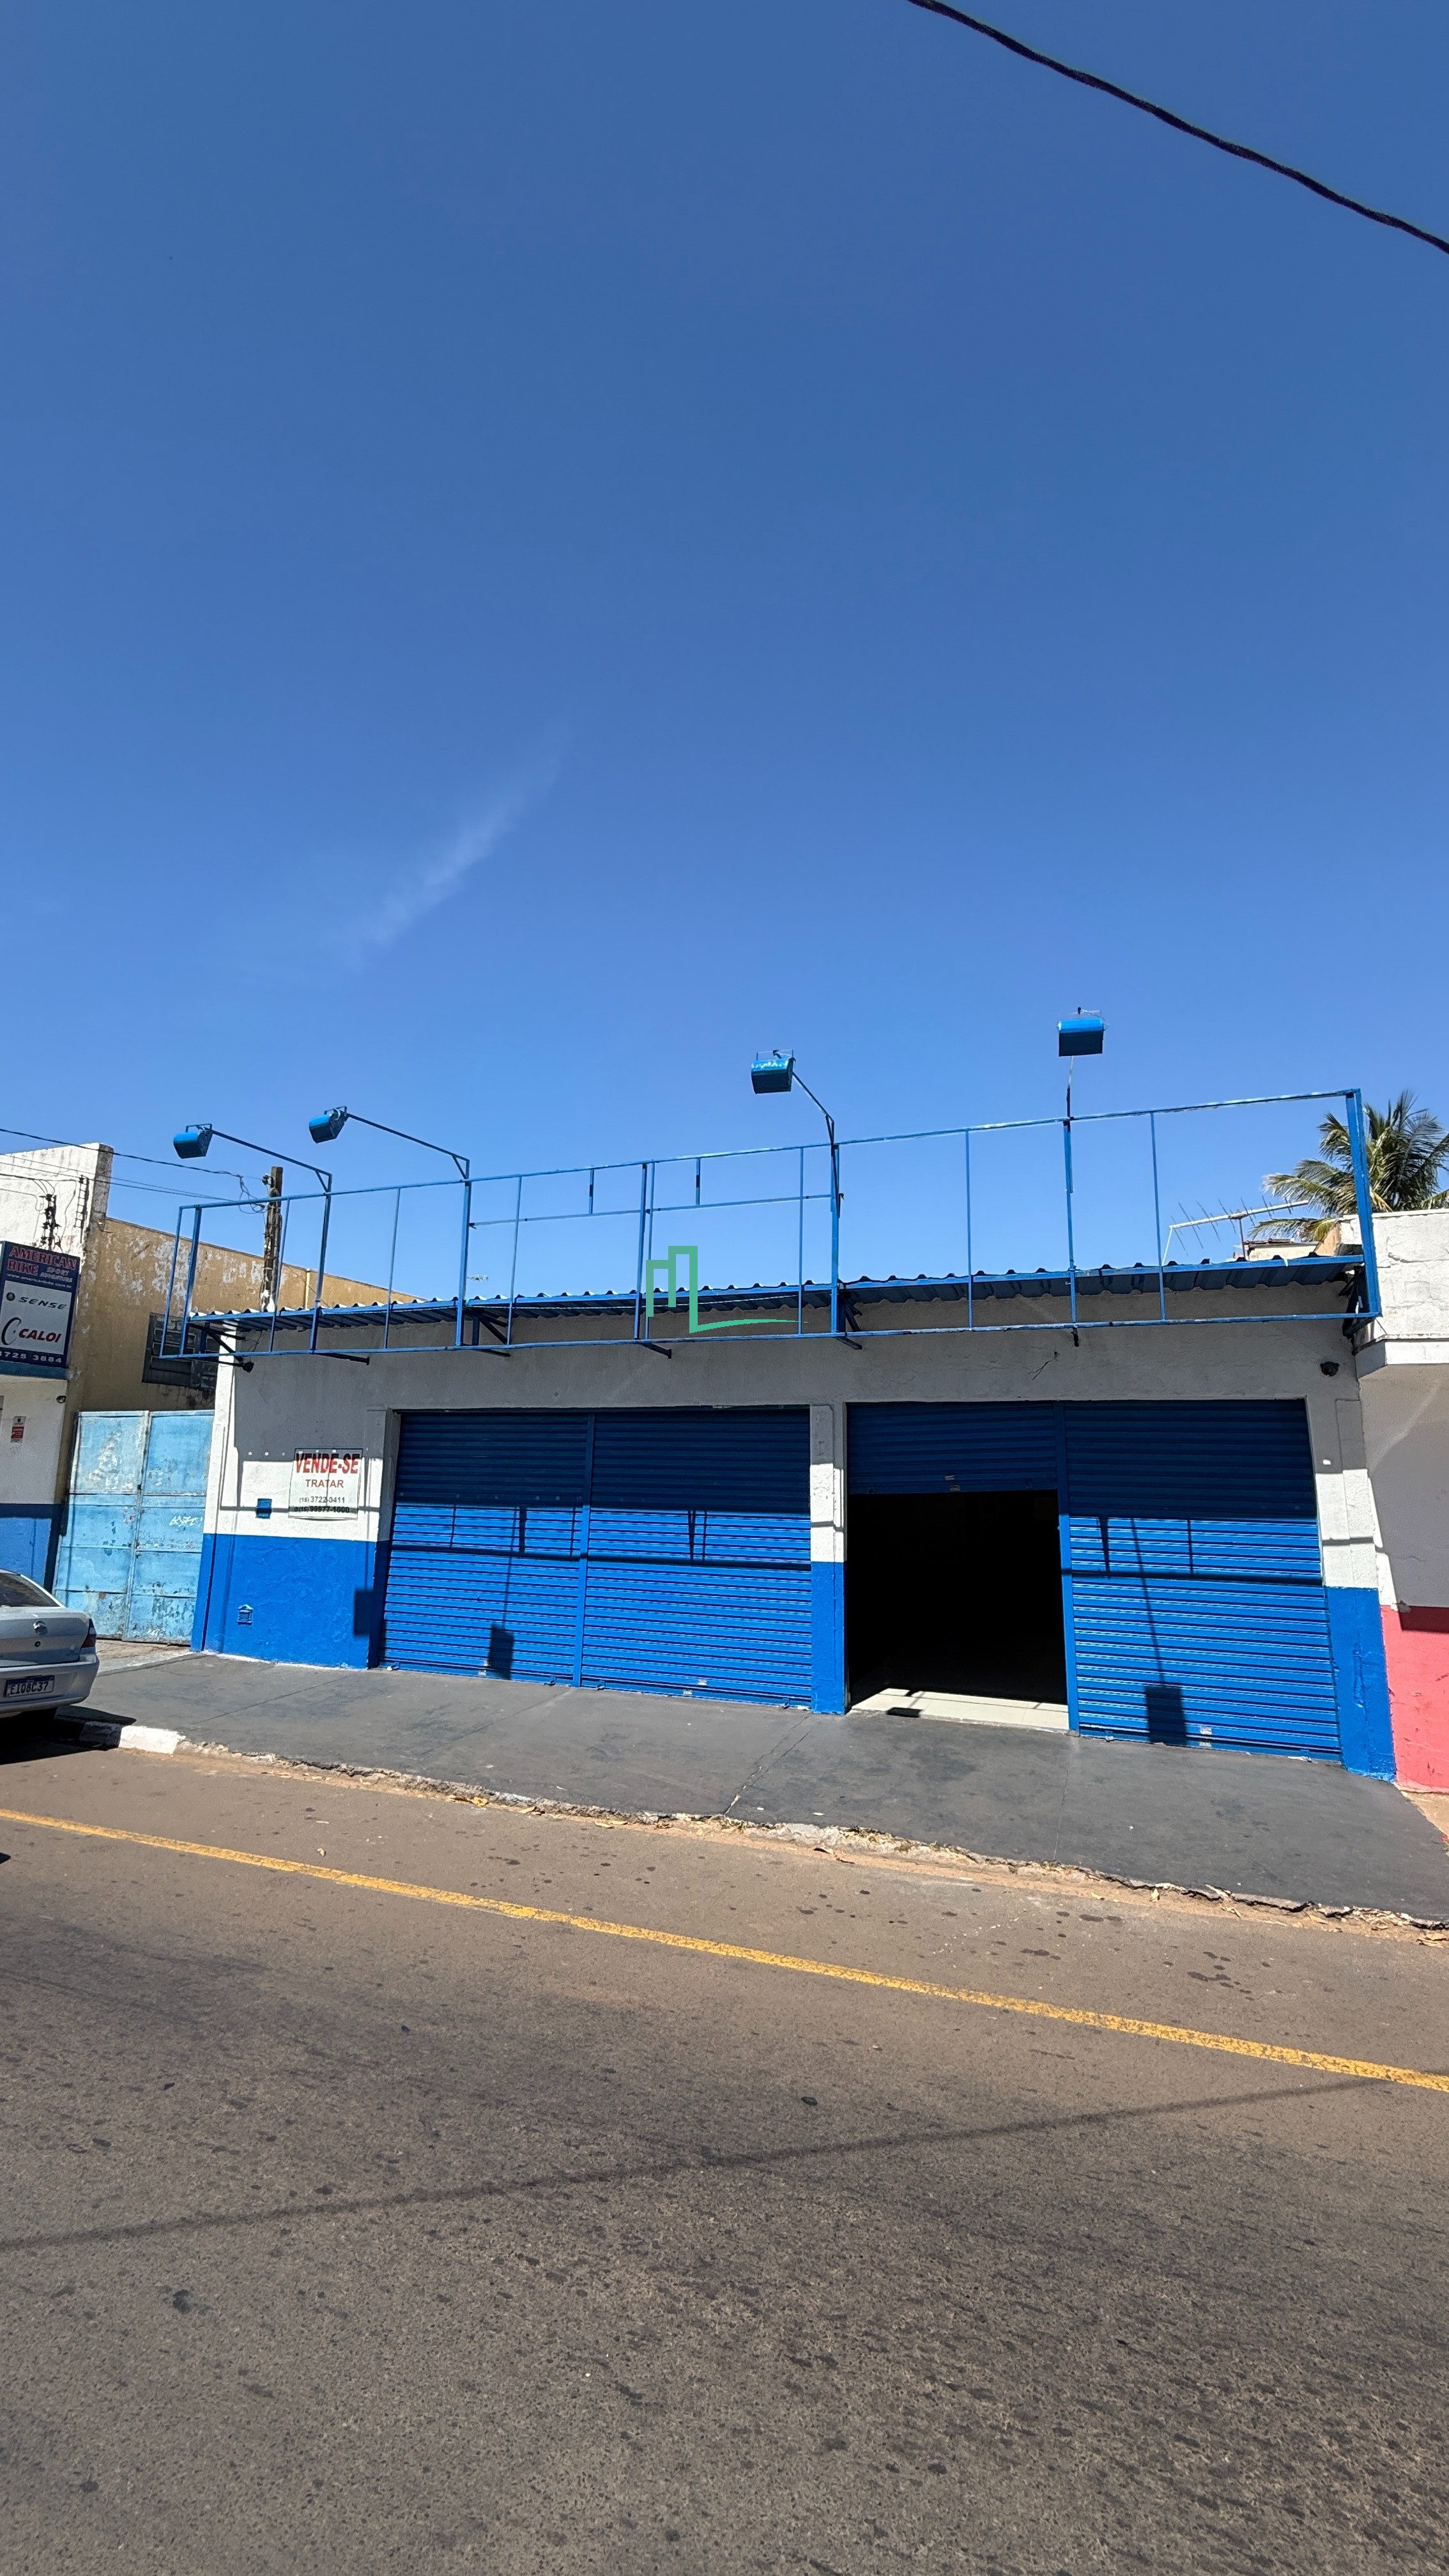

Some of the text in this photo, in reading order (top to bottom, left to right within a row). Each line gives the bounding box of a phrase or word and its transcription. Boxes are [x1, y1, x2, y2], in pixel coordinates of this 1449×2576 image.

[9, 1246, 77, 1270] AMERICAN
[7, 1259, 38, 1276] BIKE
[18, 1296, 67, 1310] SENSE
[19, 1328, 62, 1343] CALOI
[296, 1453, 360, 1474] VENDE-SE
[305, 1479, 344, 1488] TRATAR
